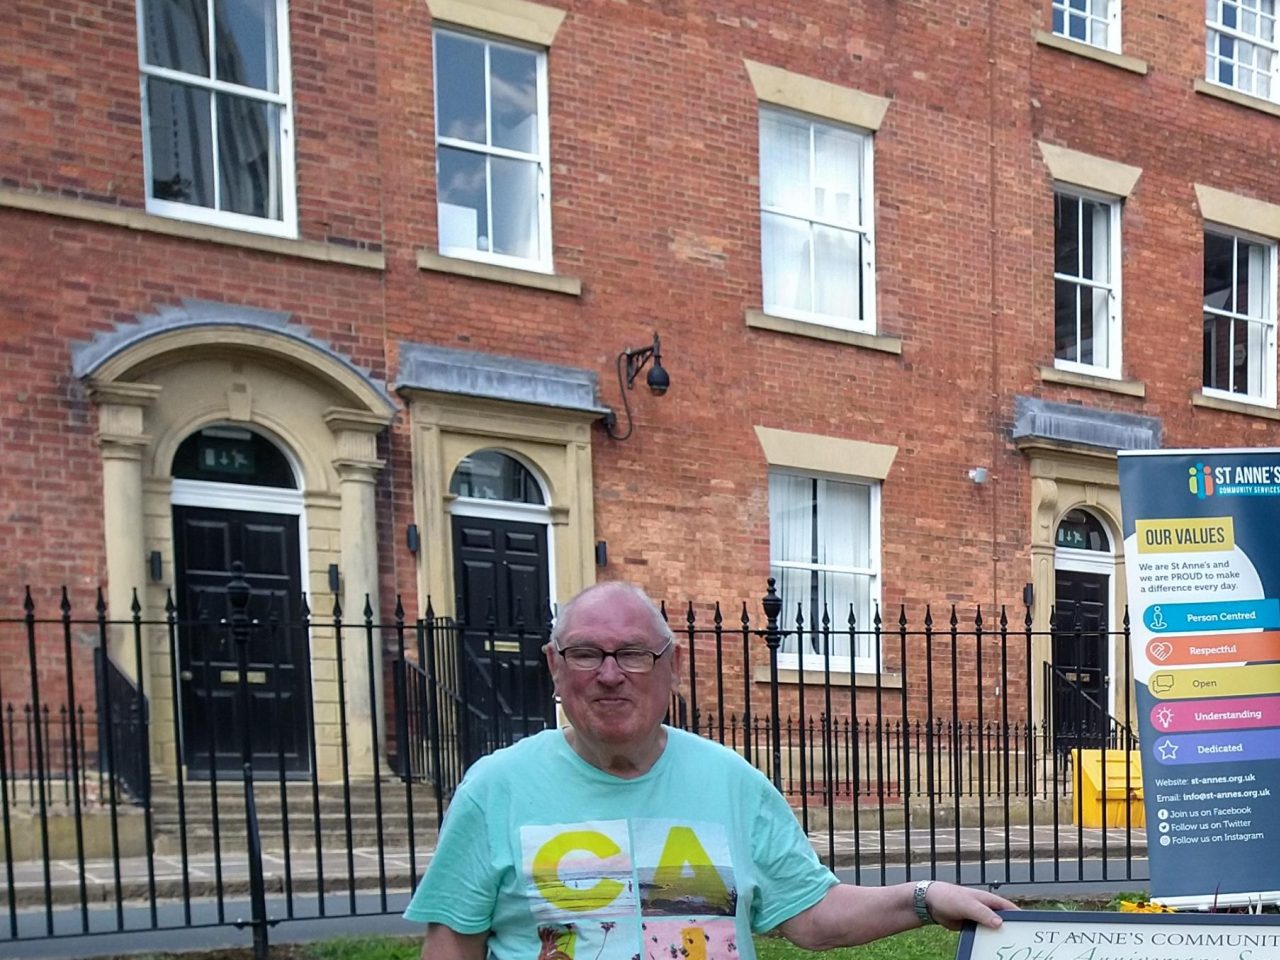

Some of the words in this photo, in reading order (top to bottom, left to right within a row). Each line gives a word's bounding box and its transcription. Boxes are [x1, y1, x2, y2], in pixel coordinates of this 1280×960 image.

[1215, 466, 1232, 484] ST
[1220, 486, 1252, 494] COMMUNITY
[1254, 486, 1280, 494] SERVICES
[1146, 528, 1172, 546] OUR
[1175, 527, 1224, 544] VALUES
[1182, 561, 1210, 570] Anne's
[1213, 560, 1230, 568] and
[1171, 572, 1202, 580] PROUD
[1216, 570, 1240, 579] make
[1148, 584, 1192, 592] difference
[1194, 584, 1218, 592] every
[1220, 582, 1238, 591] day.
[1186, 614, 1218, 622] Person
[1220, 611, 1256, 620] Centred
[1189, 645, 1237, 656] Respectful
[1192, 679, 1217, 689] Open
[1194, 710, 1262, 721] Understanding
[1197, 744, 1243, 754] Dedicated
[1155, 778, 1189, 787] Website:
[1190, 774, 1256, 785] st-annes.org.uk
[1156, 794, 1181, 802] Email:
[1182, 788, 1270, 801] info@st-annes.org.uk
[1170, 810, 1188, 818] Join
[1214, 806, 1252, 815] Facebook
[1171, 823, 1198, 831] Follow
[1222, 820, 1252, 828] Twitter
[1172, 836, 1198, 845] Follow
[1224, 832, 1264, 842] Instagram
[1034, 930, 1060, 944] ST
[1064, 932, 1144, 945] ANNE'S
